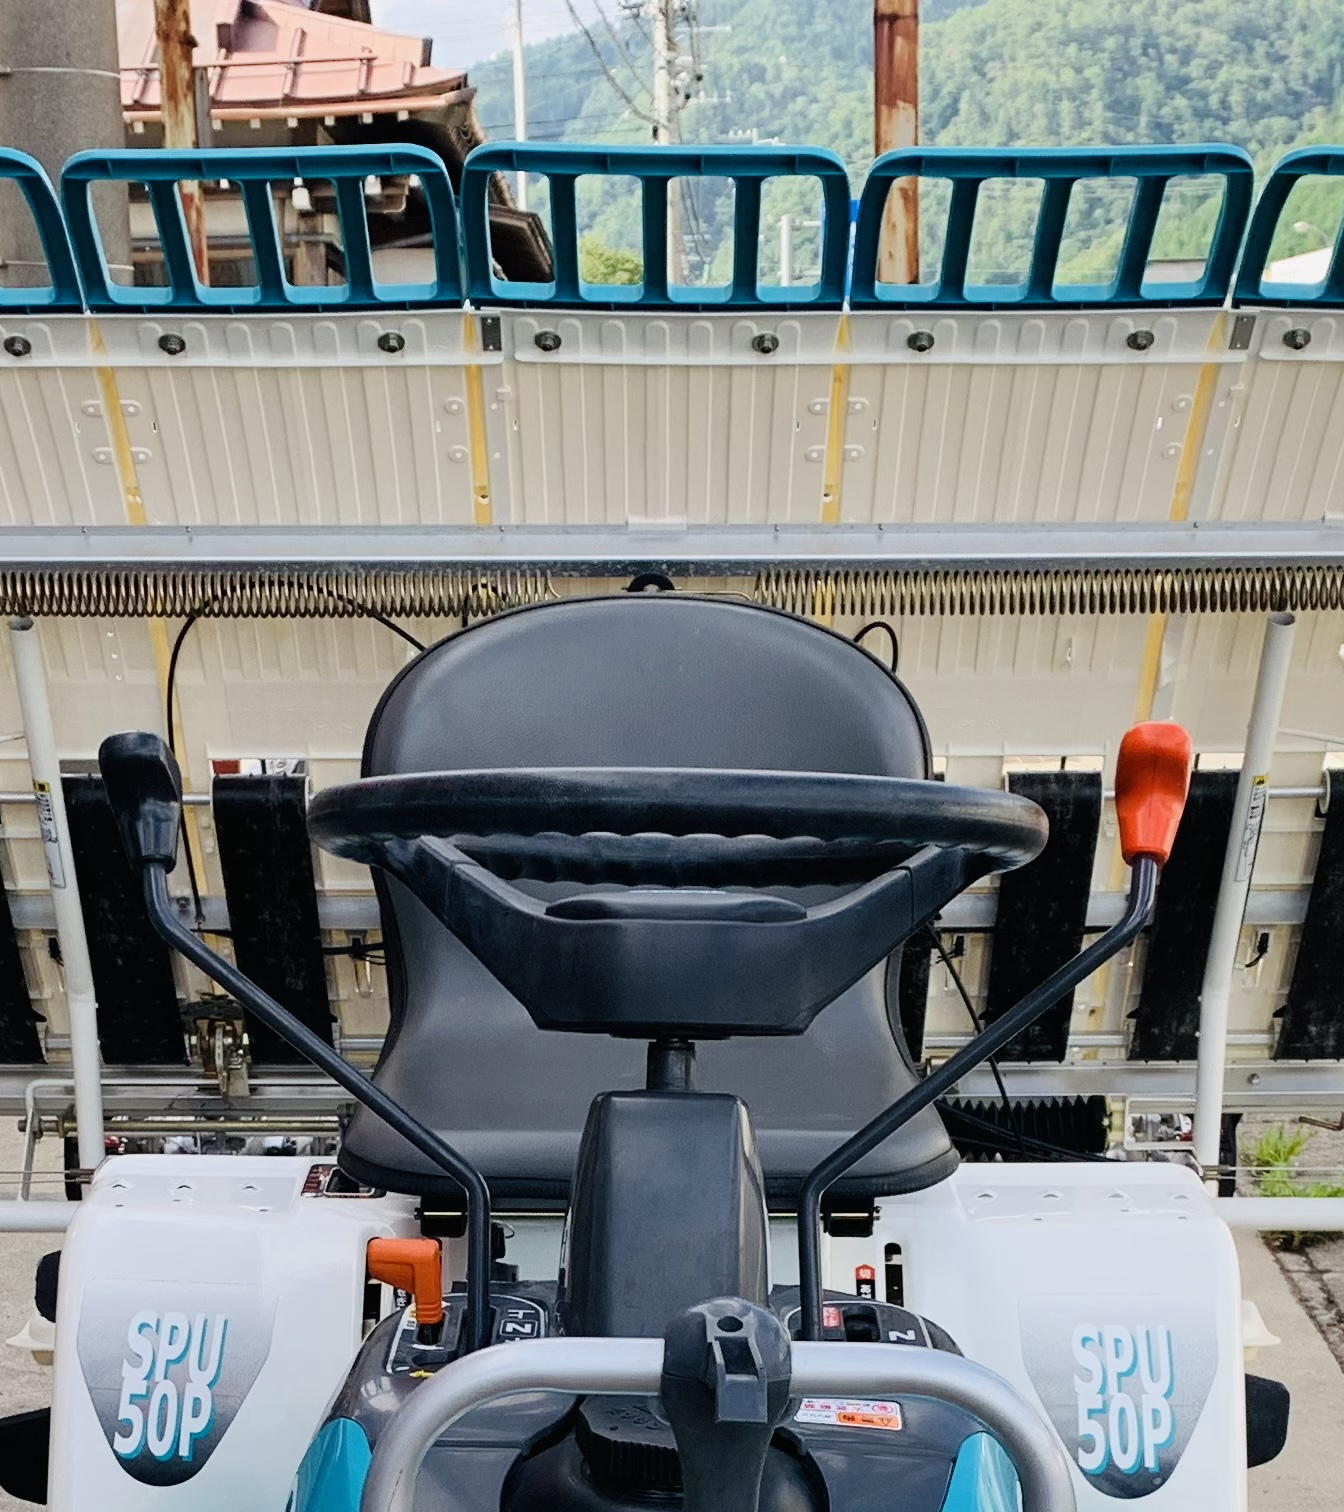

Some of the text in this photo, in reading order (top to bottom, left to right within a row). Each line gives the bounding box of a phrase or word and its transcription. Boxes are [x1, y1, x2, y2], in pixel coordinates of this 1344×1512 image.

[122, 1309, 228, 1388] SPU
[1072, 1323, 1174, 1398] SPU
[113, 1379, 216, 1462] 50P
[1076, 1393, 1177, 1475] 50P
